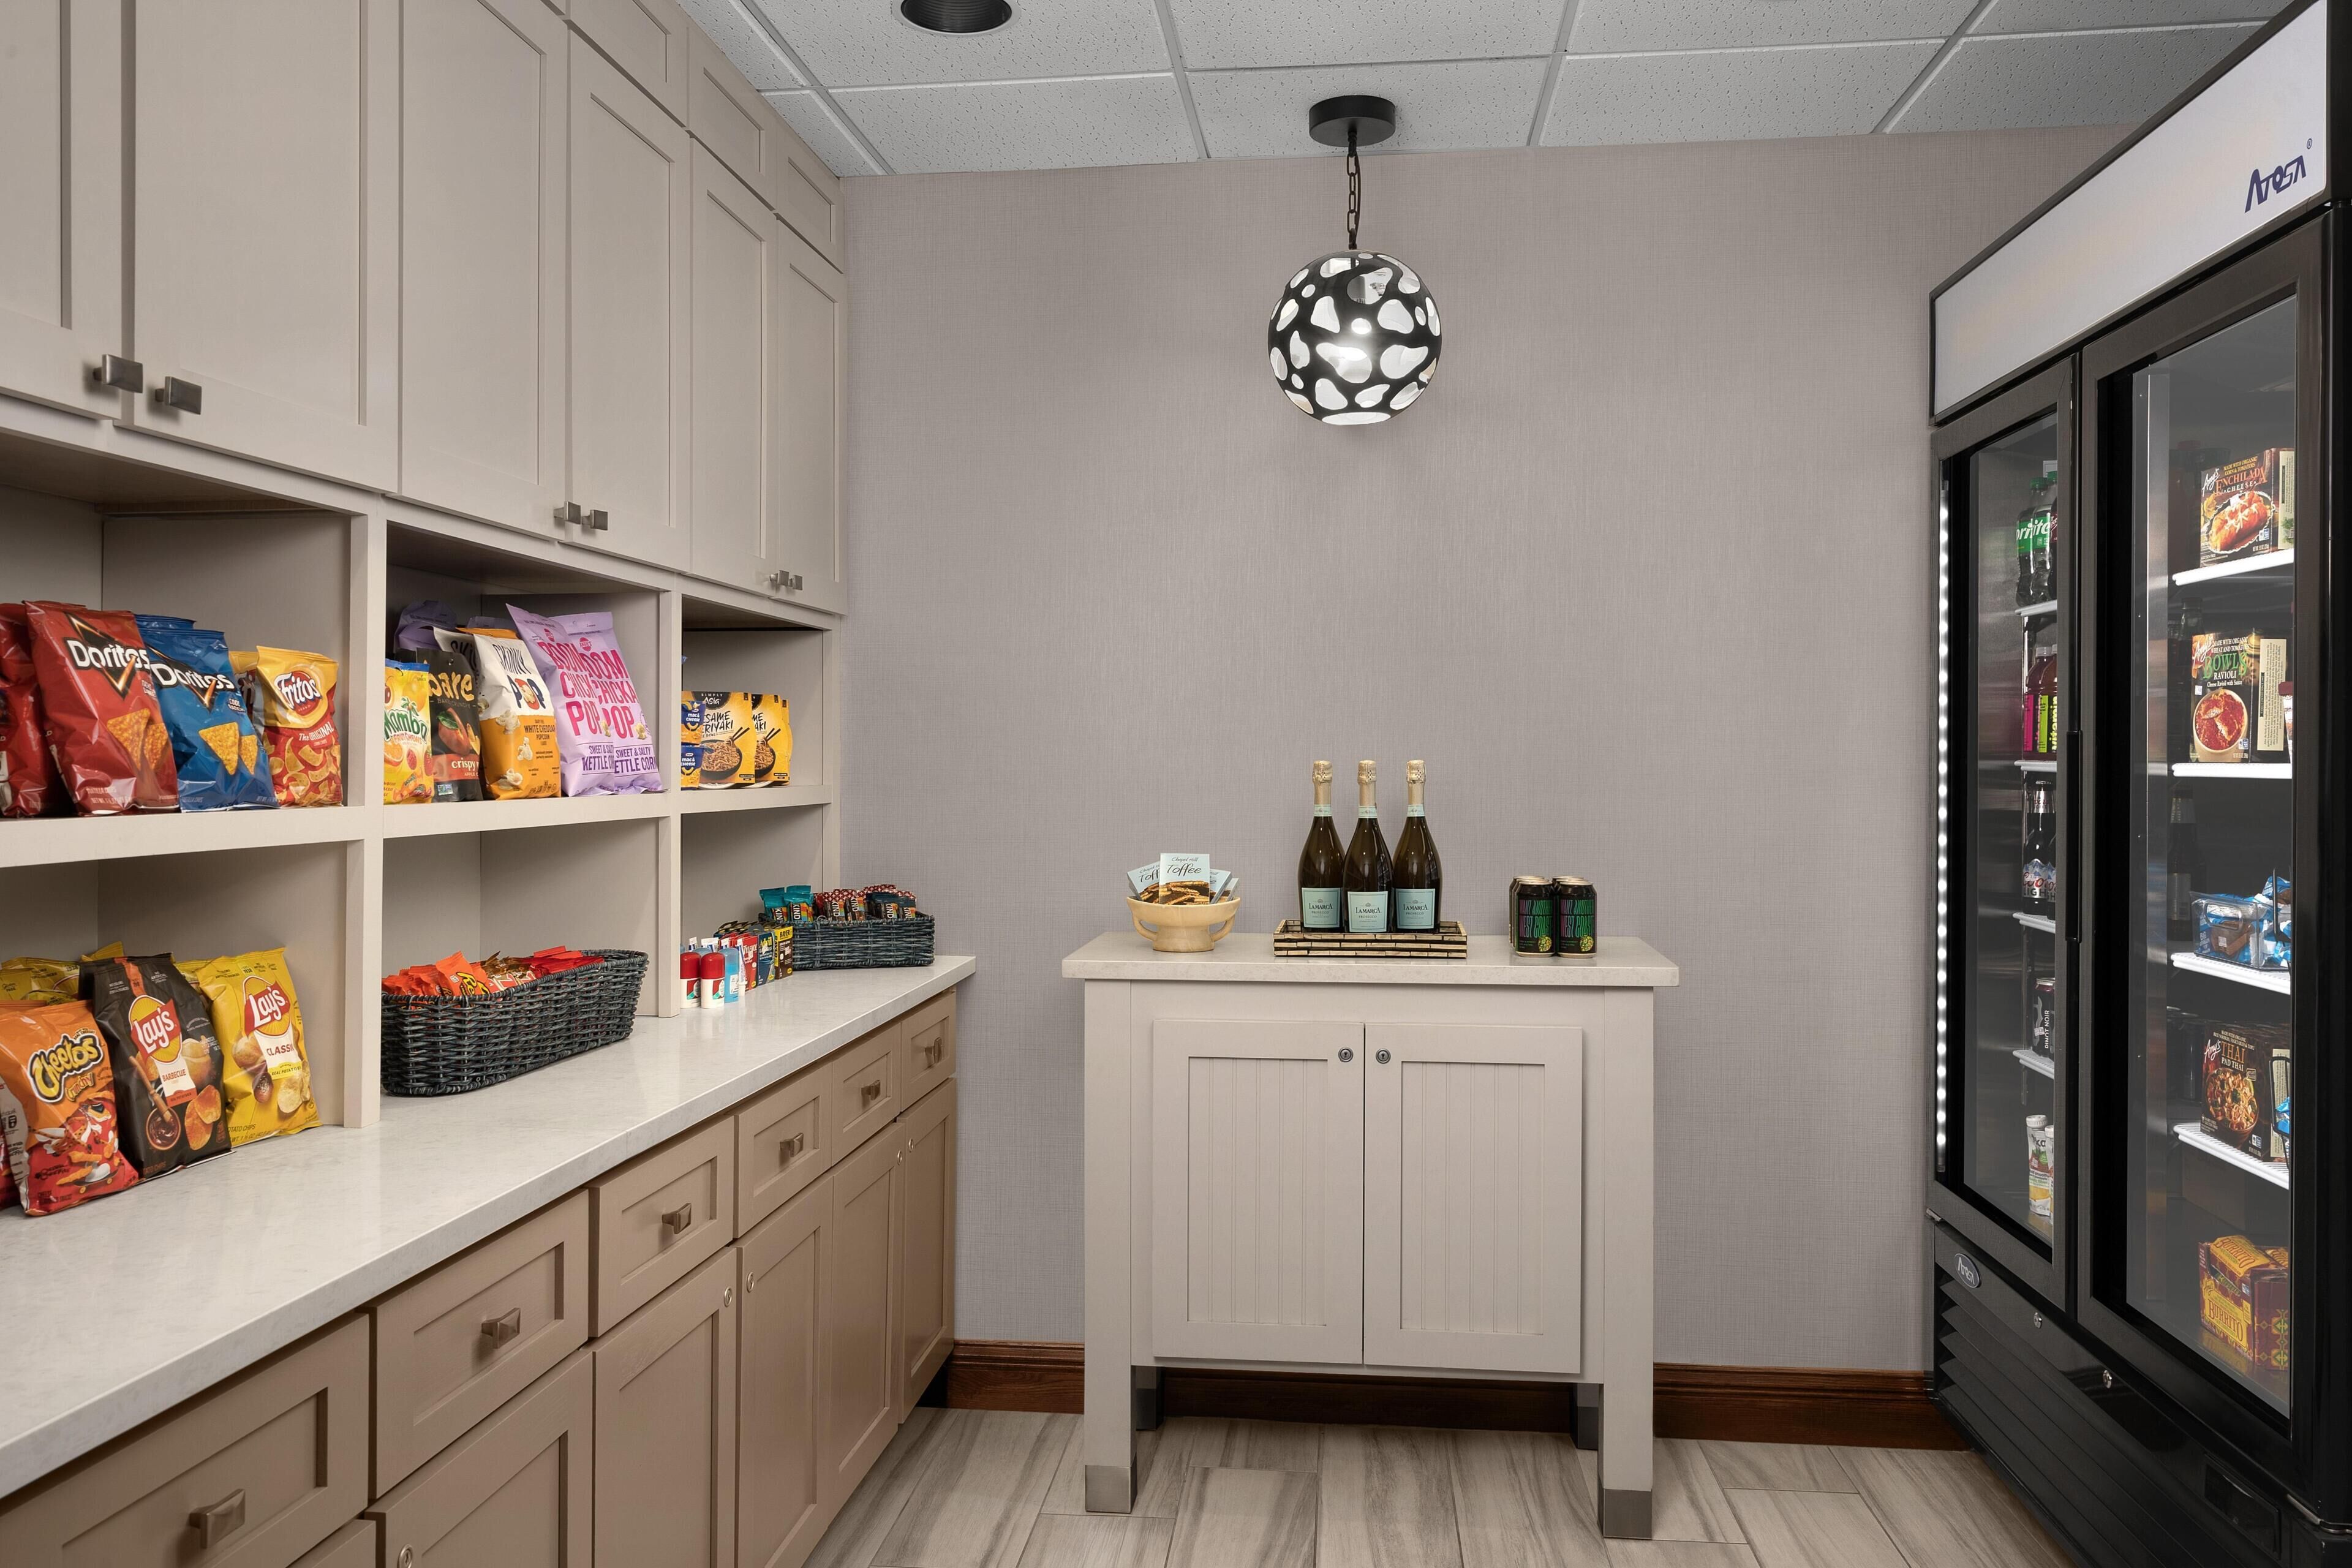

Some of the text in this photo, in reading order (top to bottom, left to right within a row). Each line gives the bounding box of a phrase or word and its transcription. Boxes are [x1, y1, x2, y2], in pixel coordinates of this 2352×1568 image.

[2226, 481, 2253, 493] CHEESE
[66, 639, 151, 670] Doritos
[2203, 652, 2248, 679] BOWLS
[151, 663, 235, 689] Doritos
[2214, 671, 2237, 680] RAVIOLI
[274, 673, 321, 709] Fritos
[524, 725, 538, 733] WHITE
[616, 750, 633, 758] SWEET
[638, 747, 651, 755] SALTY
[451, 759, 475, 772] crispy
[582, 756, 608, 771] KETTLE
[614, 758, 641, 774] ETTLE
[1139, 868, 1159, 882] Toff
[1167, 863, 1202, 876] Toffee
[780, 929, 790, 938] BAYER
[249, 986, 285, 1028] Lay's
[134, 1007, 175, 1054] Lay's
[2204, 1039, 2222, 1063] Amy's
[2221, 1041, 2245, 1064] THAI
[31, 1035, 99, 1099] Cheetos
[2221, 1057, 2244, 1072] PAD THAI
[162, 1069, 187, 1082] BARBECUE
[2215, 1238, 2255, 1268] BURRITO
[2208, 1299, 2244, 1342] BURRITO
